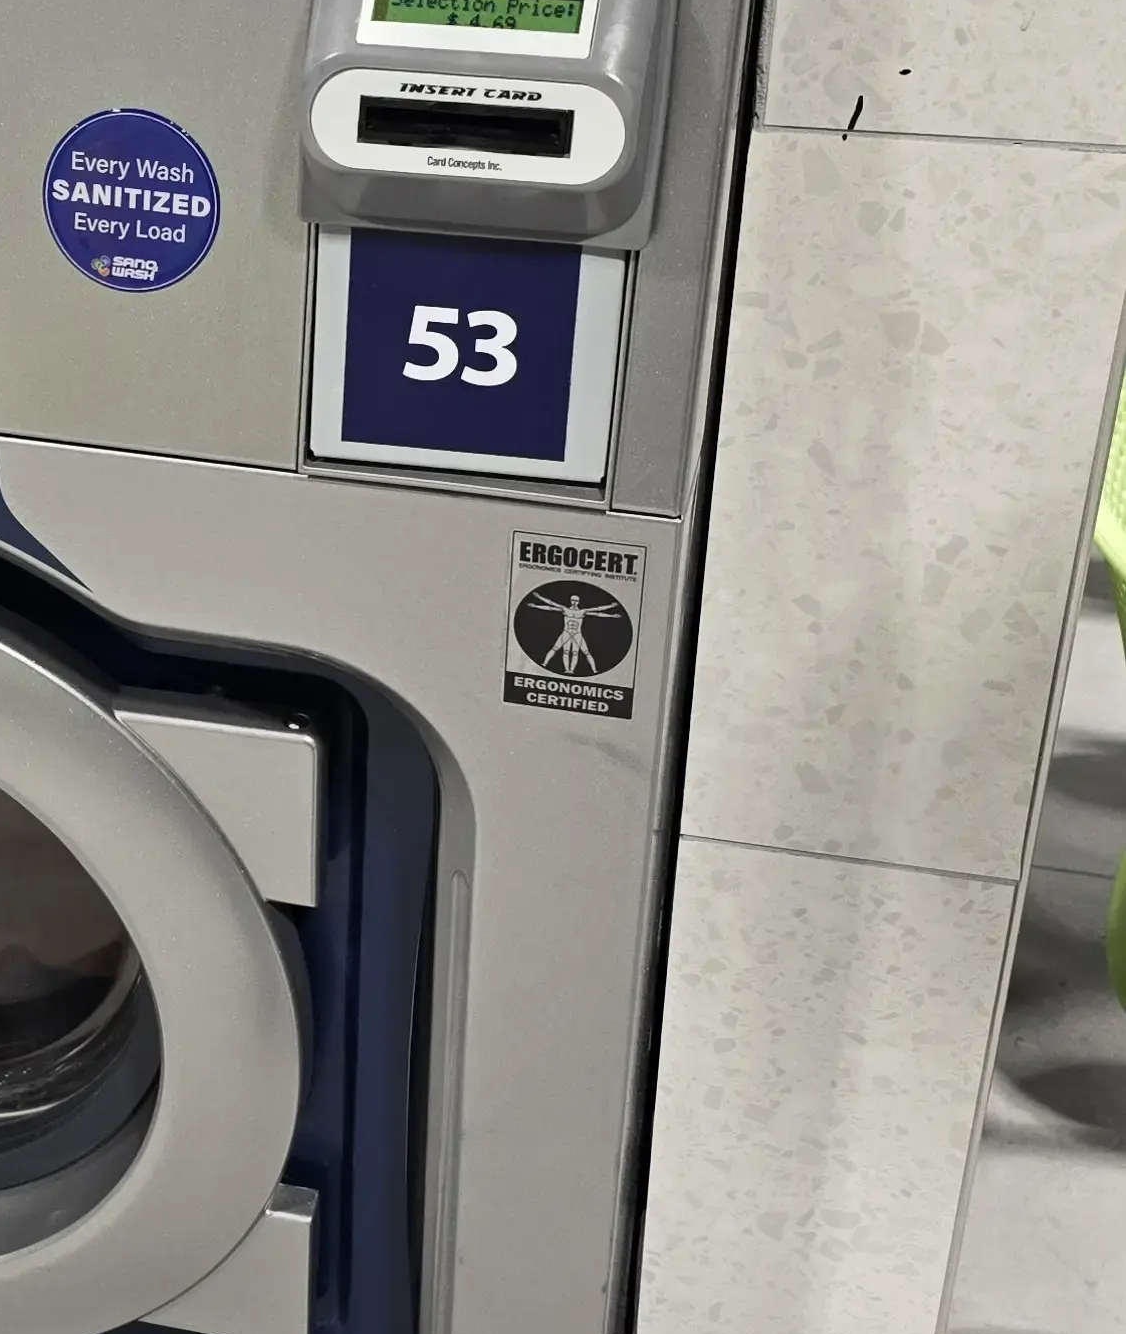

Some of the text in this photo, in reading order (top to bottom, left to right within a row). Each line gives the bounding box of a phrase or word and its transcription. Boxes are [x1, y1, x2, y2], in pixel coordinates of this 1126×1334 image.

[399, 82, 543, 102] INSERT CARD
[71, 151, 195, 183] Every Wash
[427, 156, 446, 167] Card
[448, 157, 486, 171] Concepts
[52, 179, 211, 217] SANITIZED
[74, 212, 186, 243] Every Load
[112, 267, 155, 281] WASH
[402, 305, 518, 386] 53
[513, 675, 625, 701] ERGONOMICS
[526, 692, 609, 713] CERTIFIED
